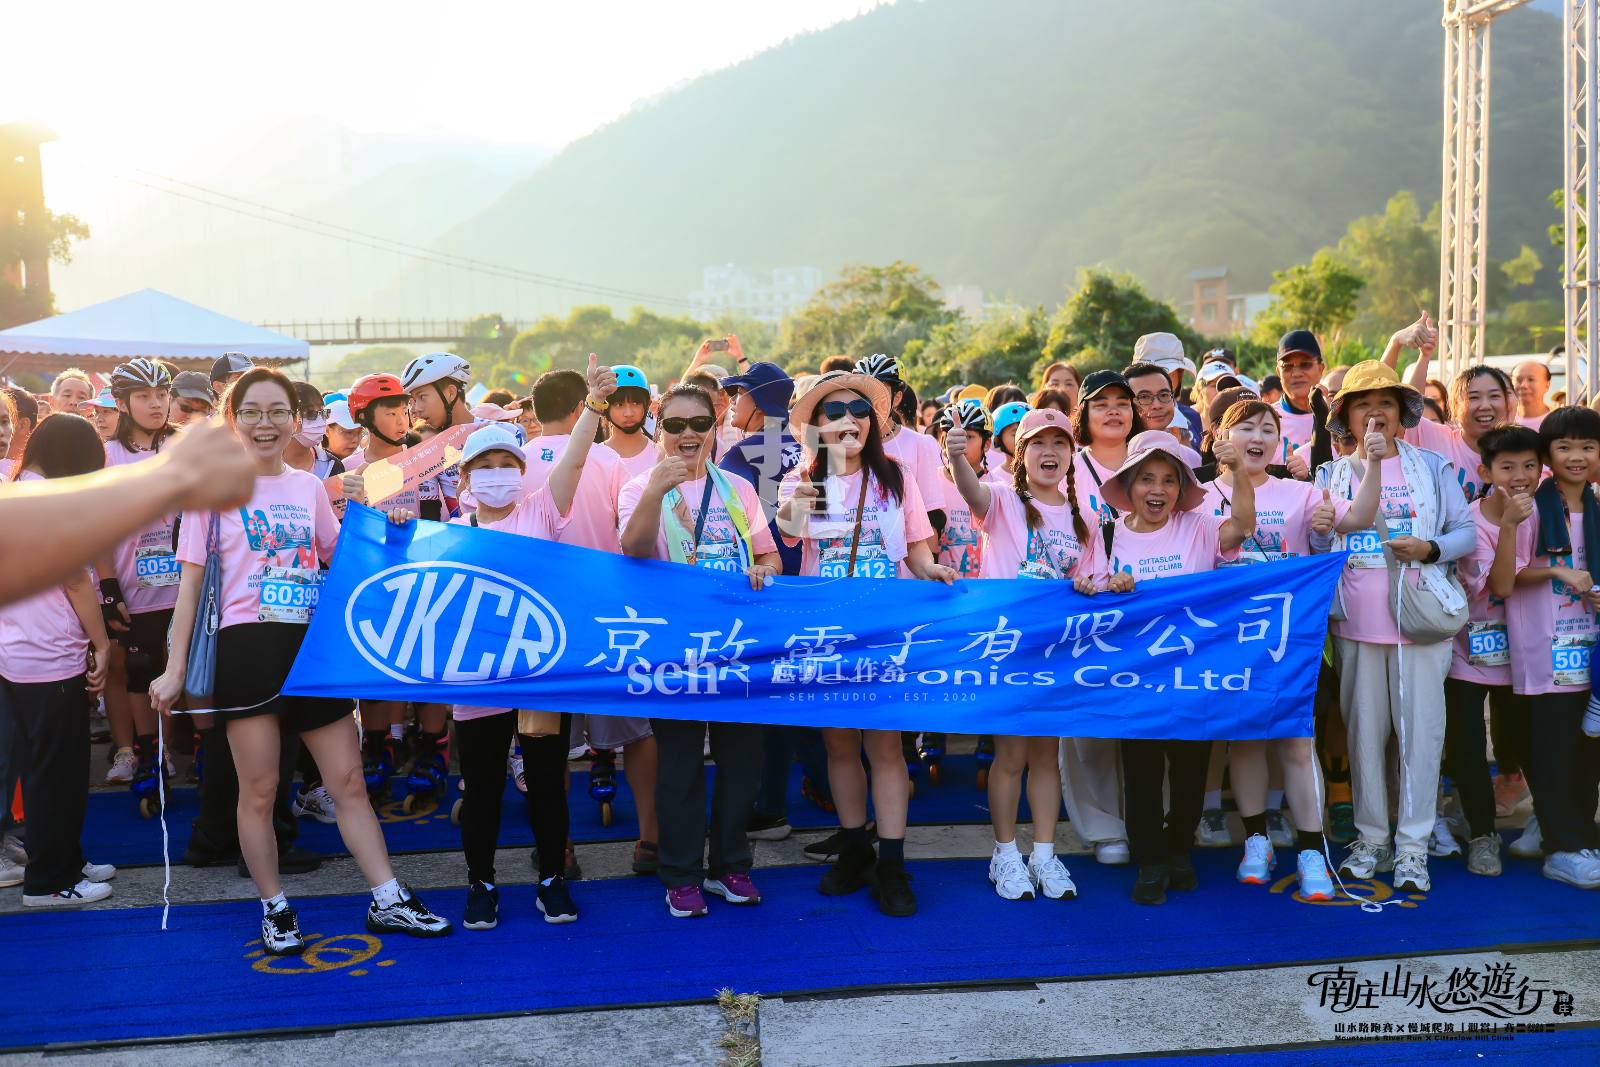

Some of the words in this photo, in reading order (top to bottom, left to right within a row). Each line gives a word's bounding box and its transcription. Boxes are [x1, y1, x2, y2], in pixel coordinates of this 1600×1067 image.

[418, 457, 447, 478] GARMIN
[1138, 554, 1181, 566] CITTASLOW
[1139, 565, 1157, 574] HILL
[1157, 562, 1183, 572] CLIMB
[263, 584, 320, 607] 60399
[358, 571, 554, 681] JKCR
[1072, 665, 1253, 693] Co.,Ltd
